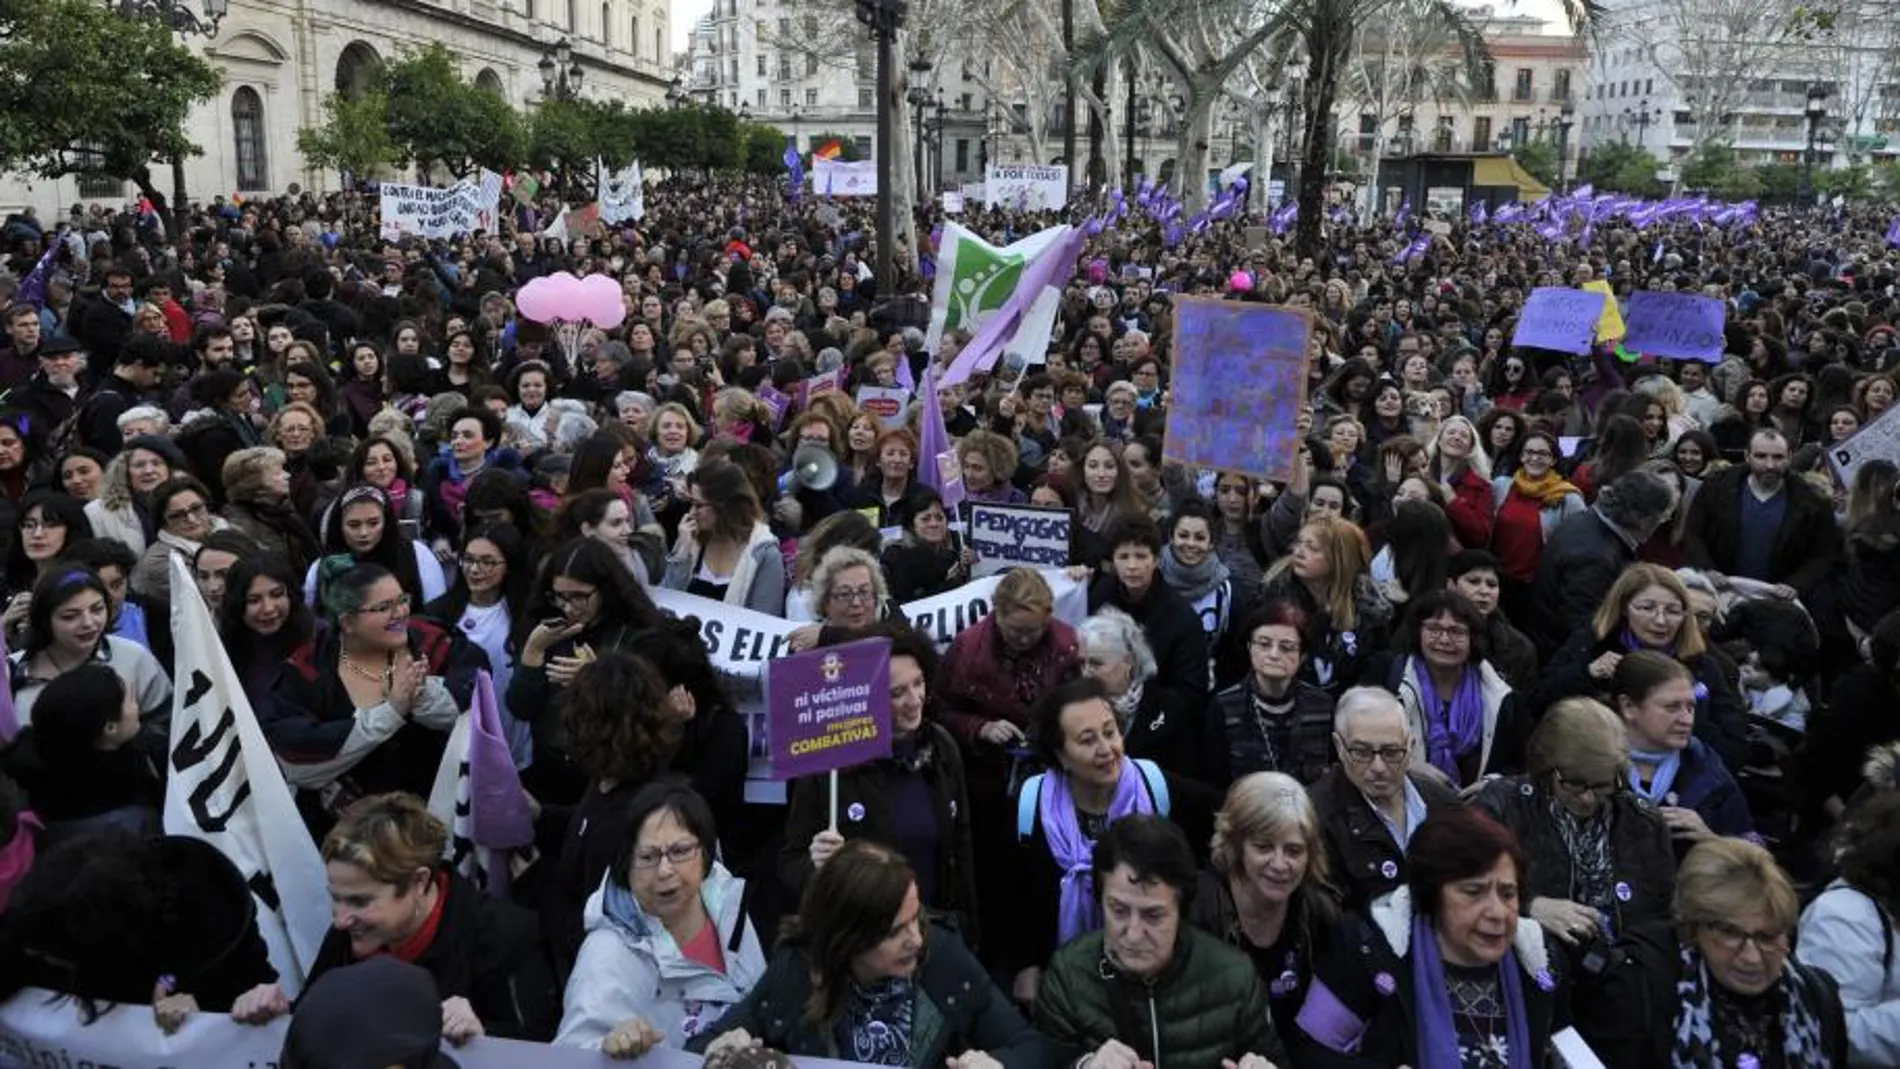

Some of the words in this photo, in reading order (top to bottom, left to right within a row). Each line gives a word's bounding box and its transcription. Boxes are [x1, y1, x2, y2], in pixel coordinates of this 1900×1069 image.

[1003, 169, 1024, 180] POR
[974, 509, 1070, 541] PEDAGOGAS
[794, 692, 808, 708] ni
[812, 684, 870, 704] víctimas
[798, 708, 812, 724] ni
[816, 701, 868, 723] pasivas
[790, 725, 877, 755] COMBATIVAS
